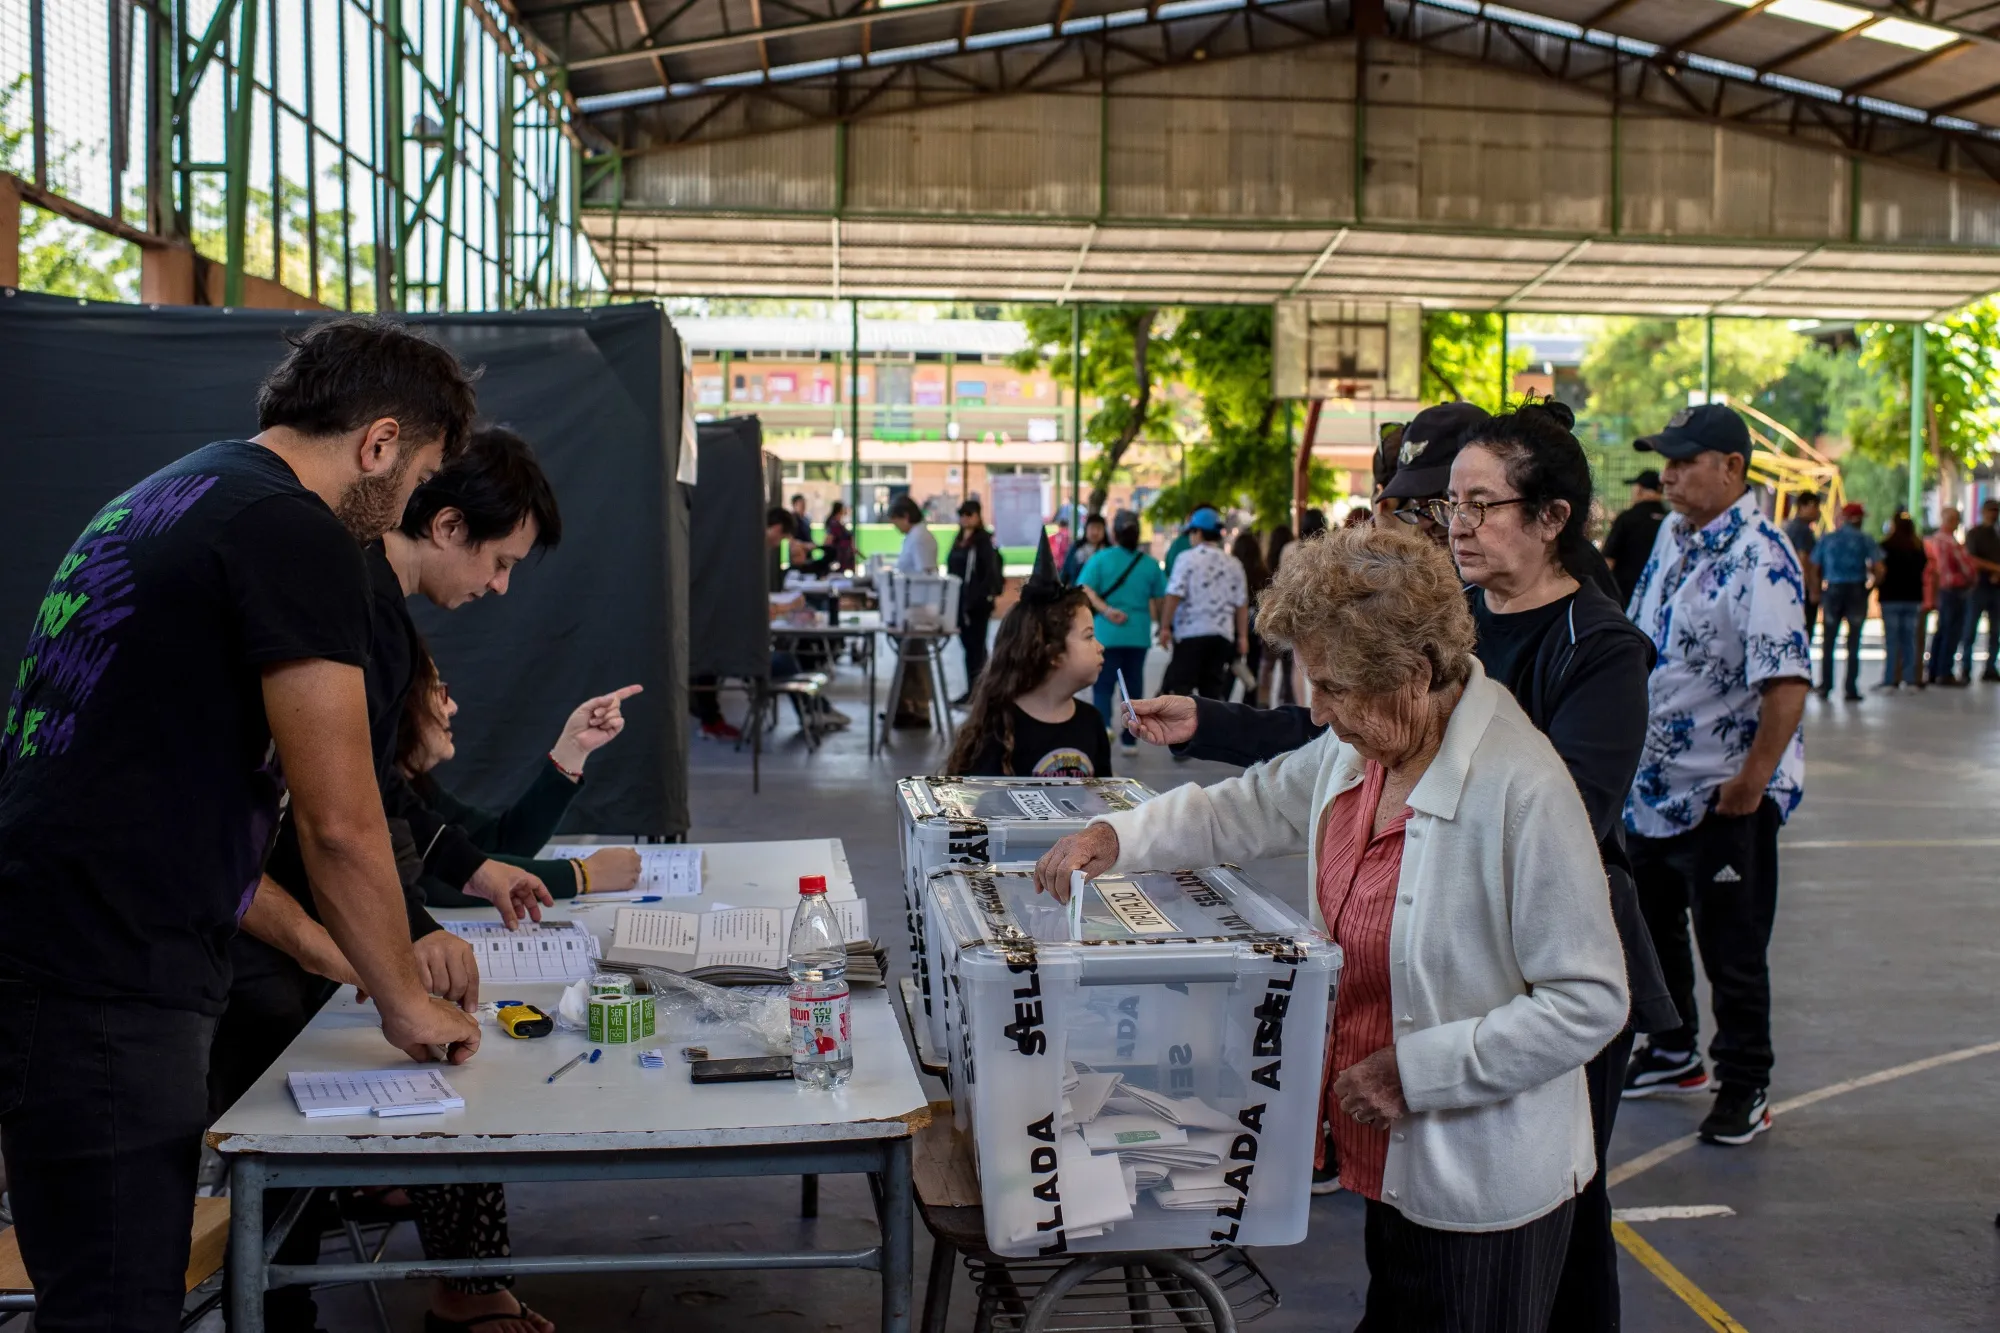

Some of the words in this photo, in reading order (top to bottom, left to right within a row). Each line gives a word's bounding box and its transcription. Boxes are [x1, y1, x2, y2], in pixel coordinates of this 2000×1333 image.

[1111, 892, 1163, 926] DIPUTADO
[645, 1002, 653, 1011] SER
[591, 1007, 600, 1016] SER
[611, 1008, 624, 1017] SER
[645, 1010, 653, 1019] VEL
[813, 1008, 831, 1016] CCU
[591, 1016, 600, 1025] VEL
[611, 1017, 623, 1025] VEL
